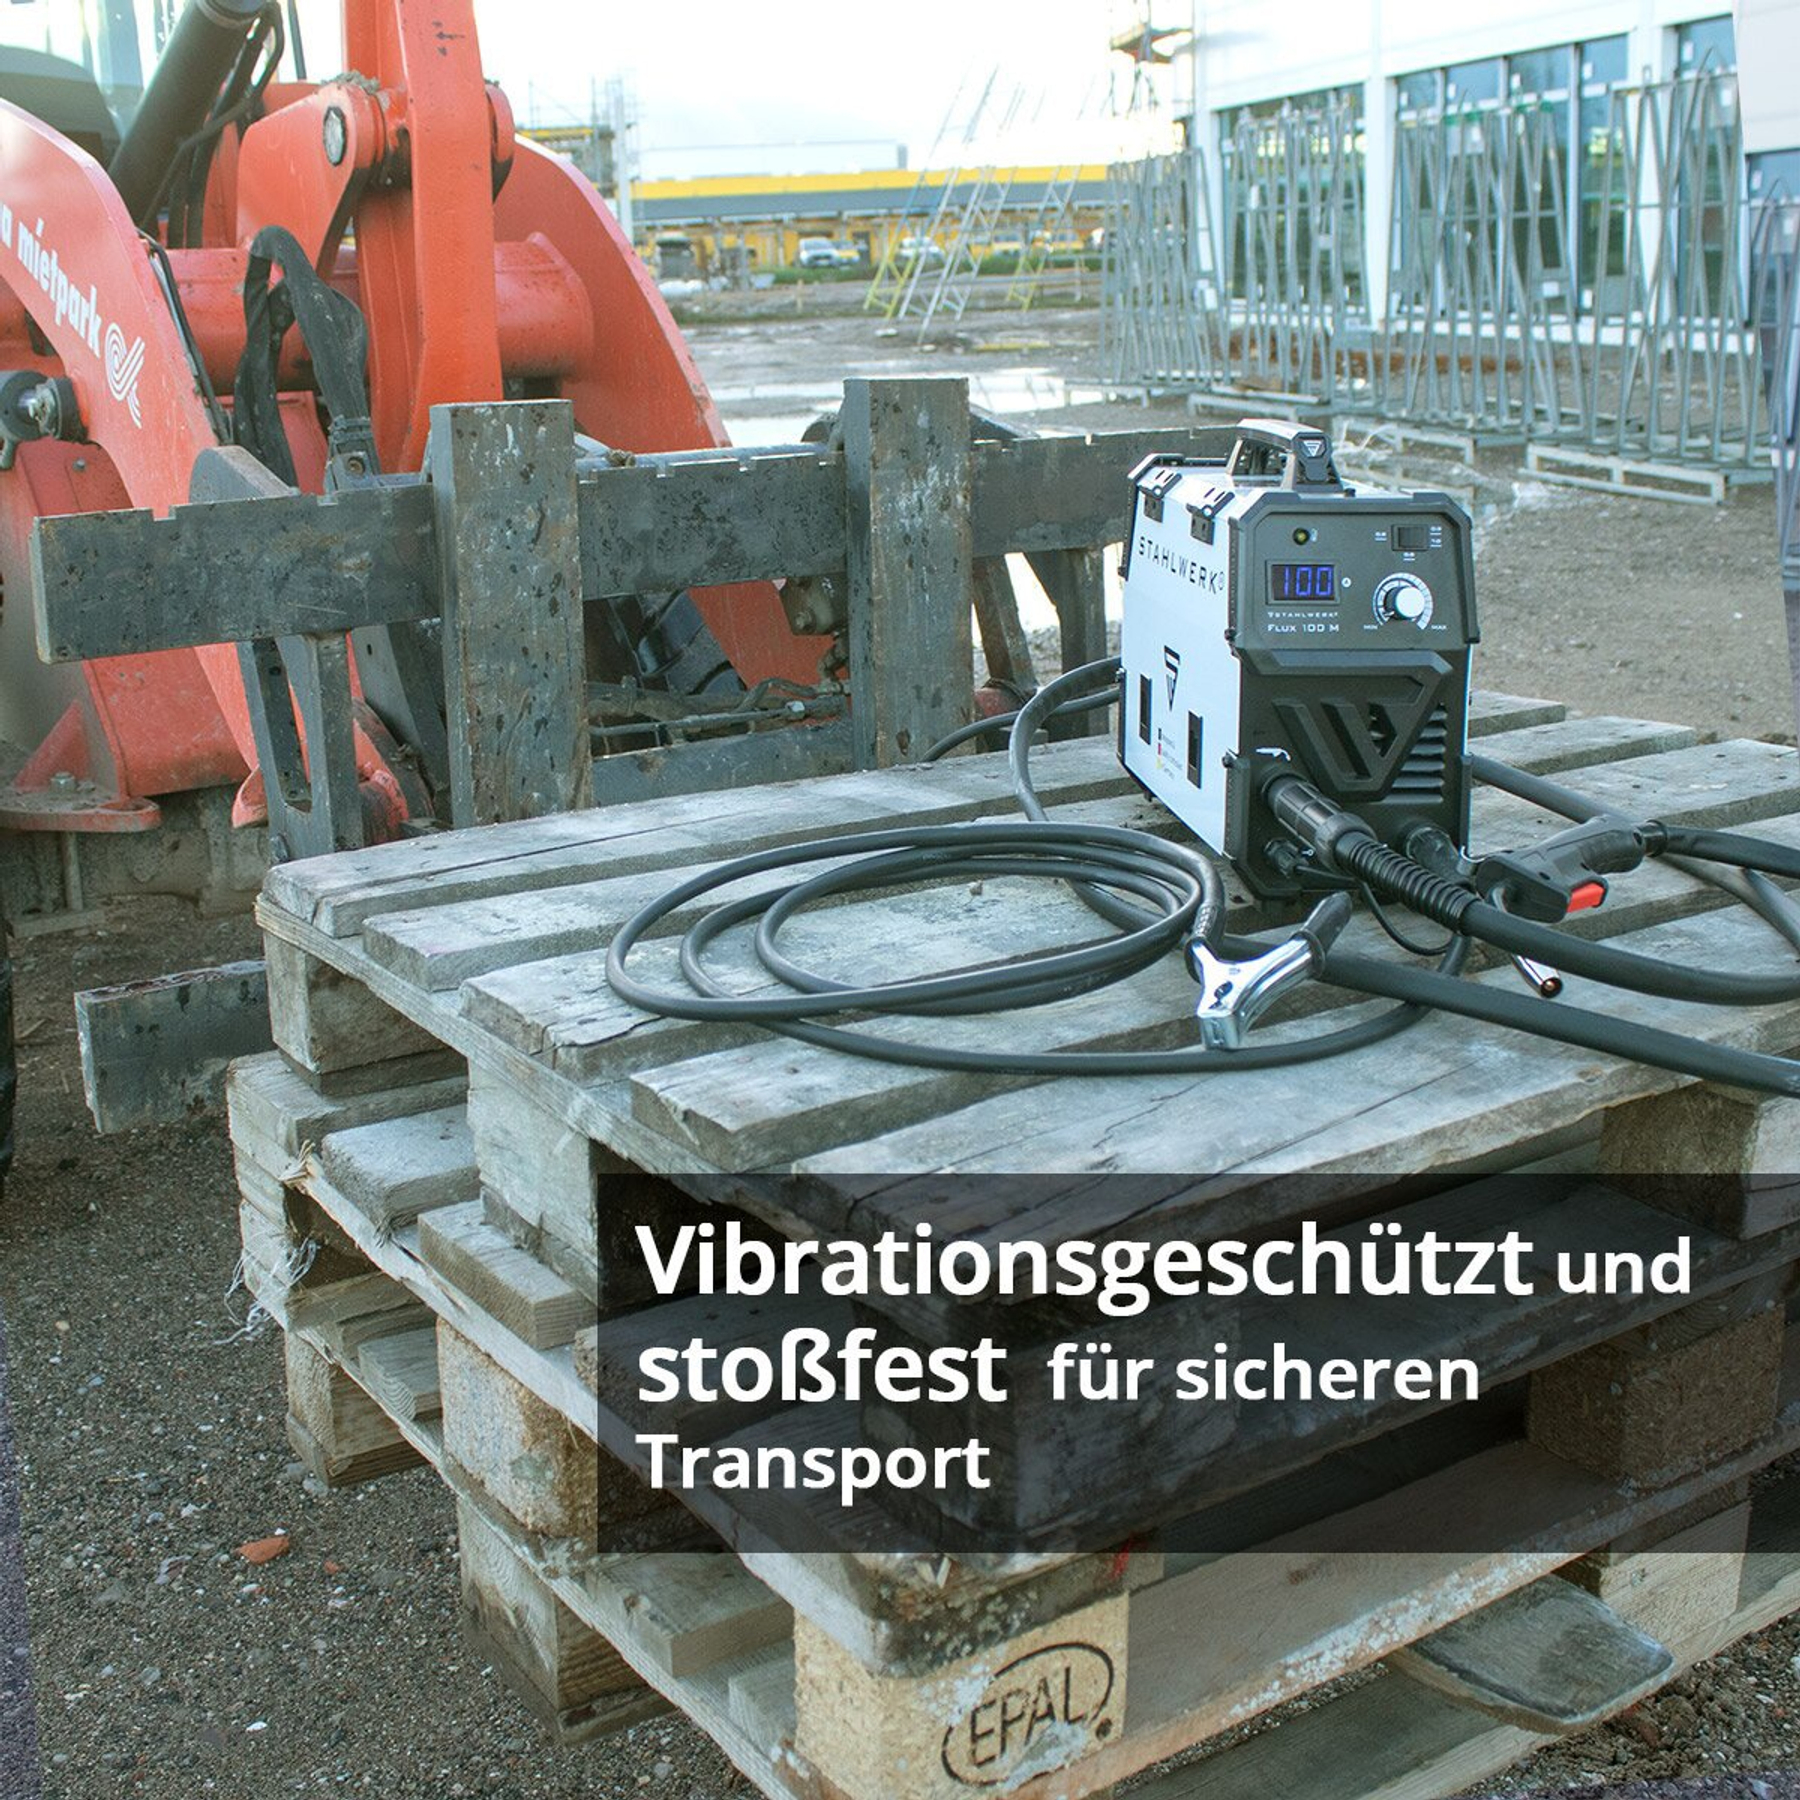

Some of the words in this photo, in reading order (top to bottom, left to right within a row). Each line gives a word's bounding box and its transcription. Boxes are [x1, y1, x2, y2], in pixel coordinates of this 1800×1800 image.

[18, 217, 102, 358] mietpark
[1284, 566, 1332, 596] 100
[970, 1666, 1084, 1768] EPAL
